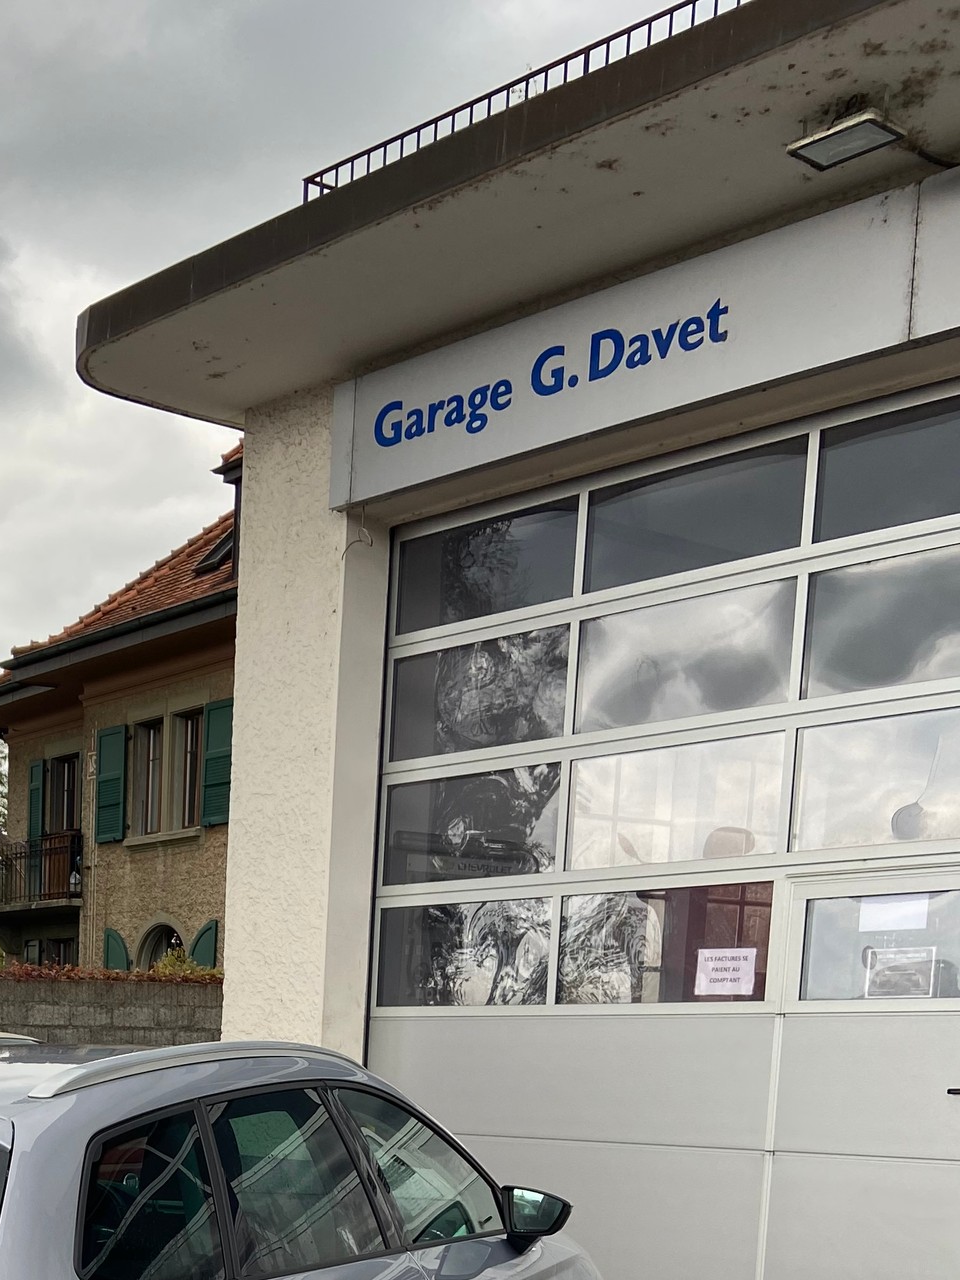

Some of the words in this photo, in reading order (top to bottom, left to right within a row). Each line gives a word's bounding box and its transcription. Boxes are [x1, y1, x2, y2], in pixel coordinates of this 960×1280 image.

[374, 379, 512, 447] Garage
[531, 346, 578, 396] G.
[589, 298, 729, 382] Davet
[458, 862, 513, 874] CHEVROLET
